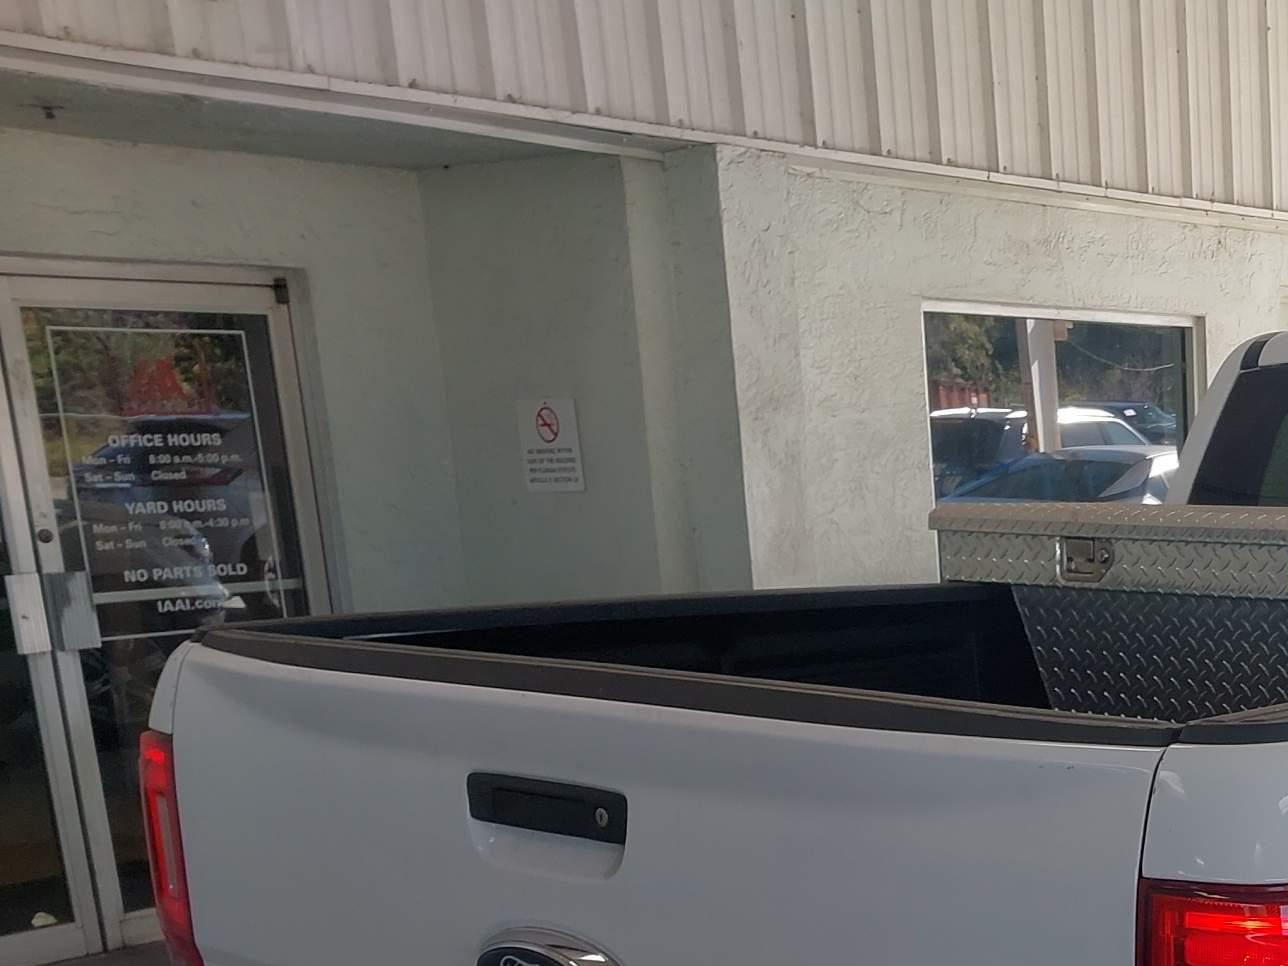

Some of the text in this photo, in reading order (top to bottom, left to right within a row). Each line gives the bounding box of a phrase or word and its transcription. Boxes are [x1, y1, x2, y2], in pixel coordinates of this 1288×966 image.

[107, 432, 222, 448] OFFICE HOURS
[151, 469, 187, 480] Closed
[125, 499, 227, 515] YARD HOURS
[123, 563, 248, 583] NO PARTS SOLD
